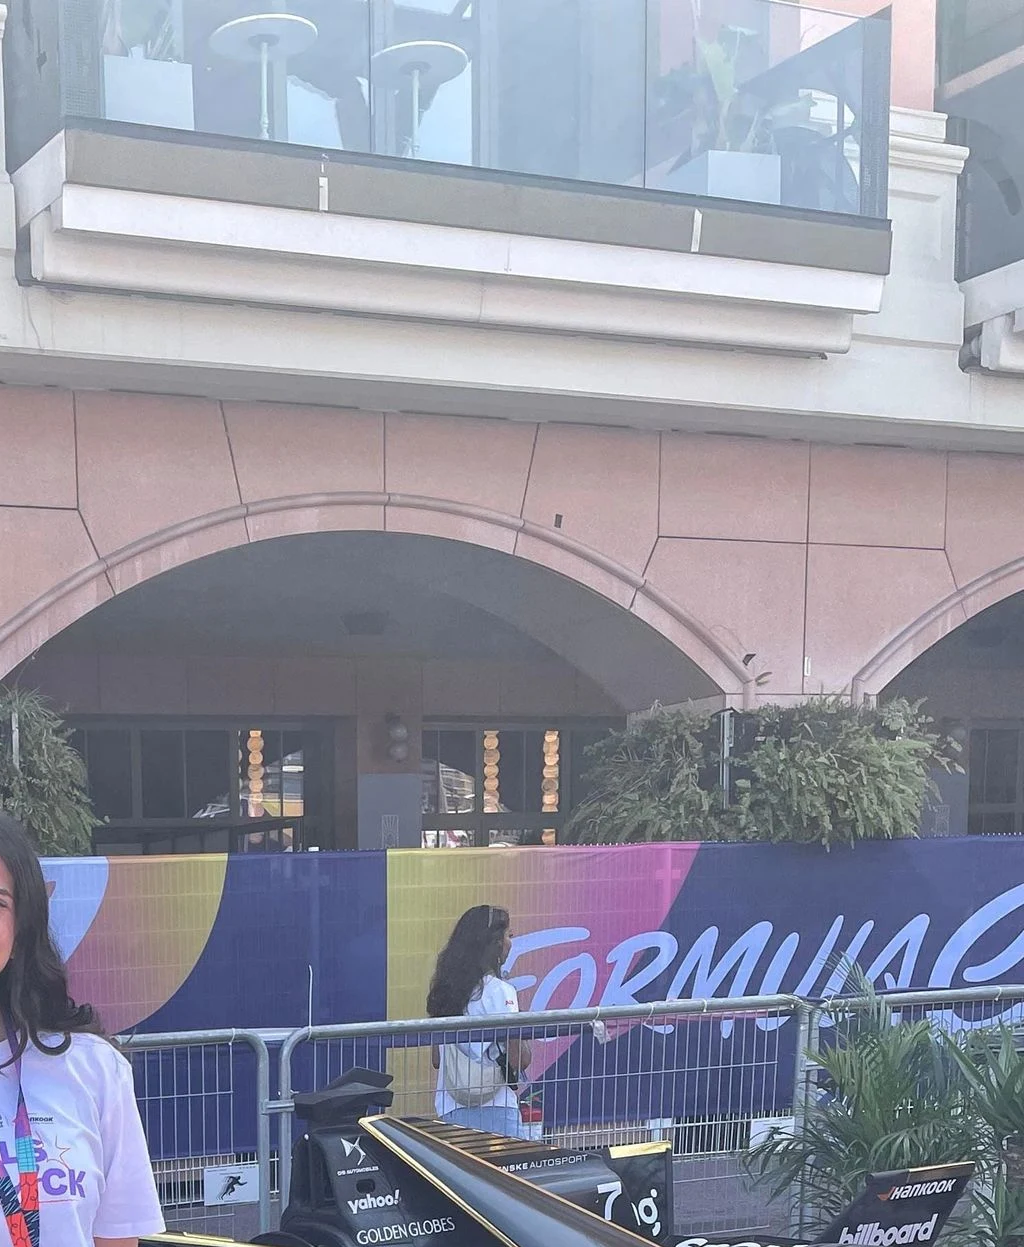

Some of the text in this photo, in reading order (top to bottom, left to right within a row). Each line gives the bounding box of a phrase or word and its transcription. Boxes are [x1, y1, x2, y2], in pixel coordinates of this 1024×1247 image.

[529, 1154, 588, 1169] AUTOSPORT
[347, 1189, 400, 1215] yahoo!
[356, 1217, 456, 1245] GOLDEN GLOBES
[838, 1213, 938, 1247] billboard
